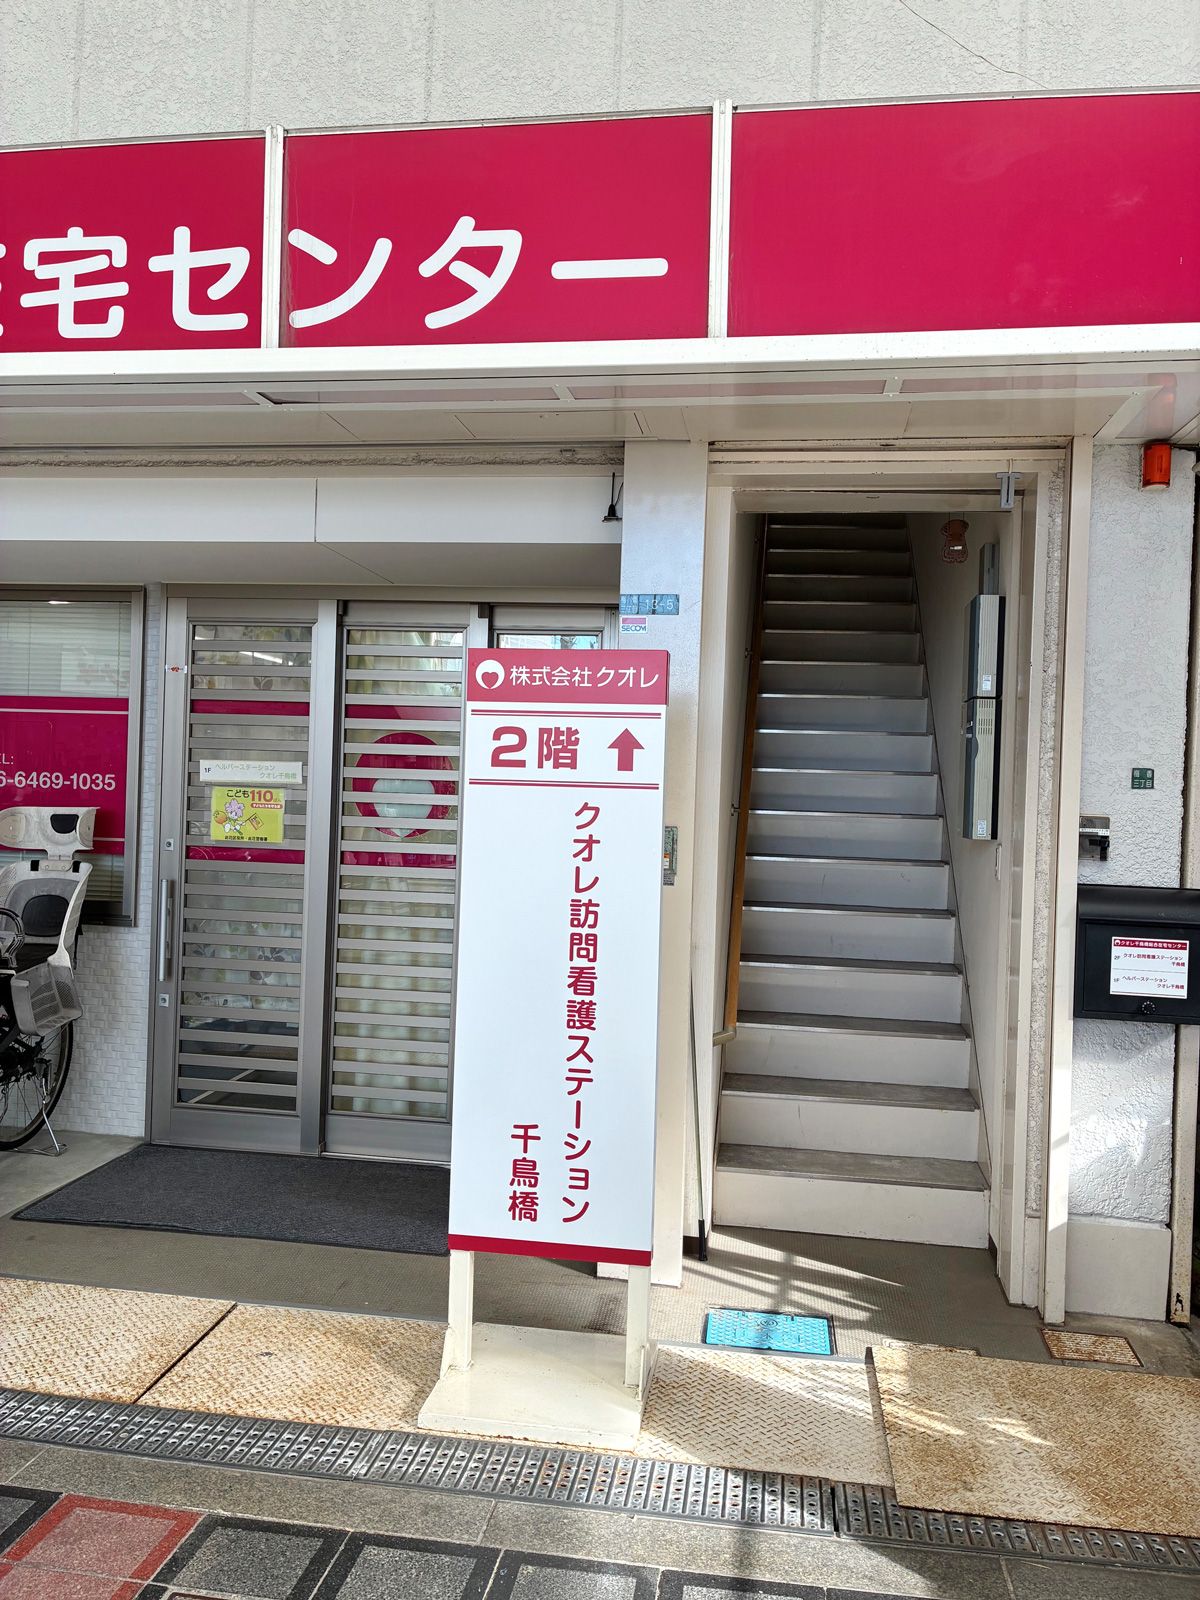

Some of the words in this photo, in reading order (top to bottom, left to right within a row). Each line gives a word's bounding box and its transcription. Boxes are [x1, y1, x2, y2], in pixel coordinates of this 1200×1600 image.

[0, 216, 668, 339] 宅センター
[509, 665, 660, 688] 株式会社クオレ
[0, 753, 14, 765] L:
[490, 726, 580, 770] 2階
[1133, 779, 1153, 788] 三丁目
[561, 801, 600, 1224] クオレ訪問看護ステーション
[508, 1123, 541, 1223] 千鳥橋
